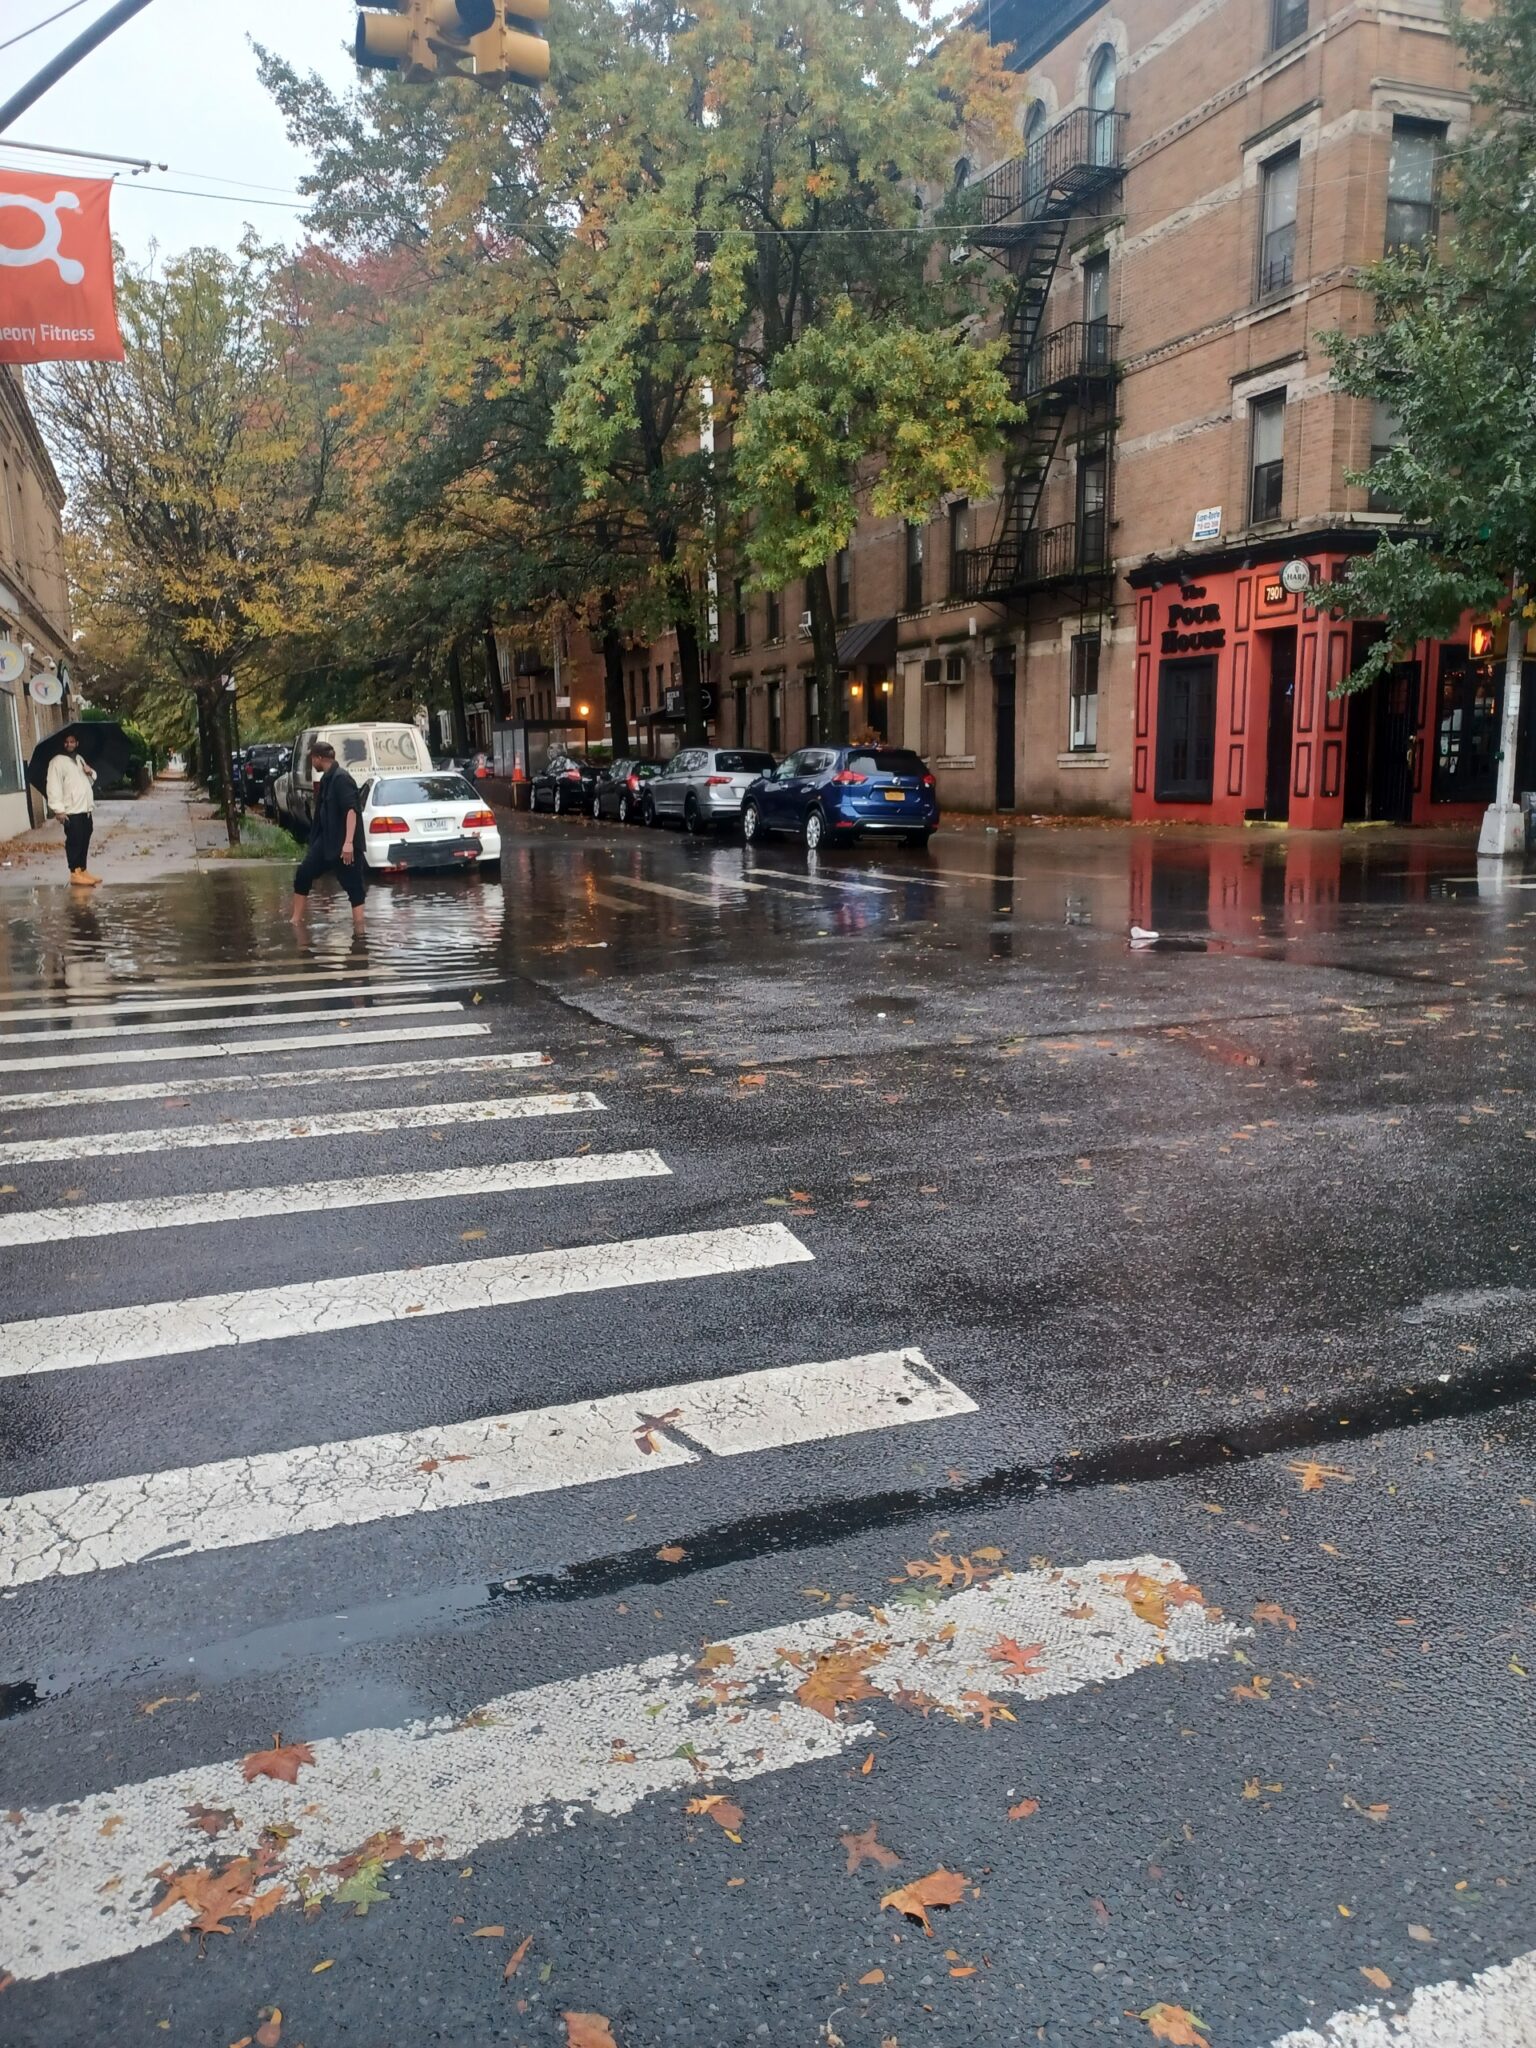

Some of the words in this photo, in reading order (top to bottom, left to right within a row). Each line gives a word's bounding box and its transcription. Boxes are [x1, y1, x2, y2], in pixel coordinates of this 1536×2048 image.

[40, 323, 96, 342] Fitness
[1286, 573, 1307, 581] HARP
[1266, 586, 1283, 601] 7901
